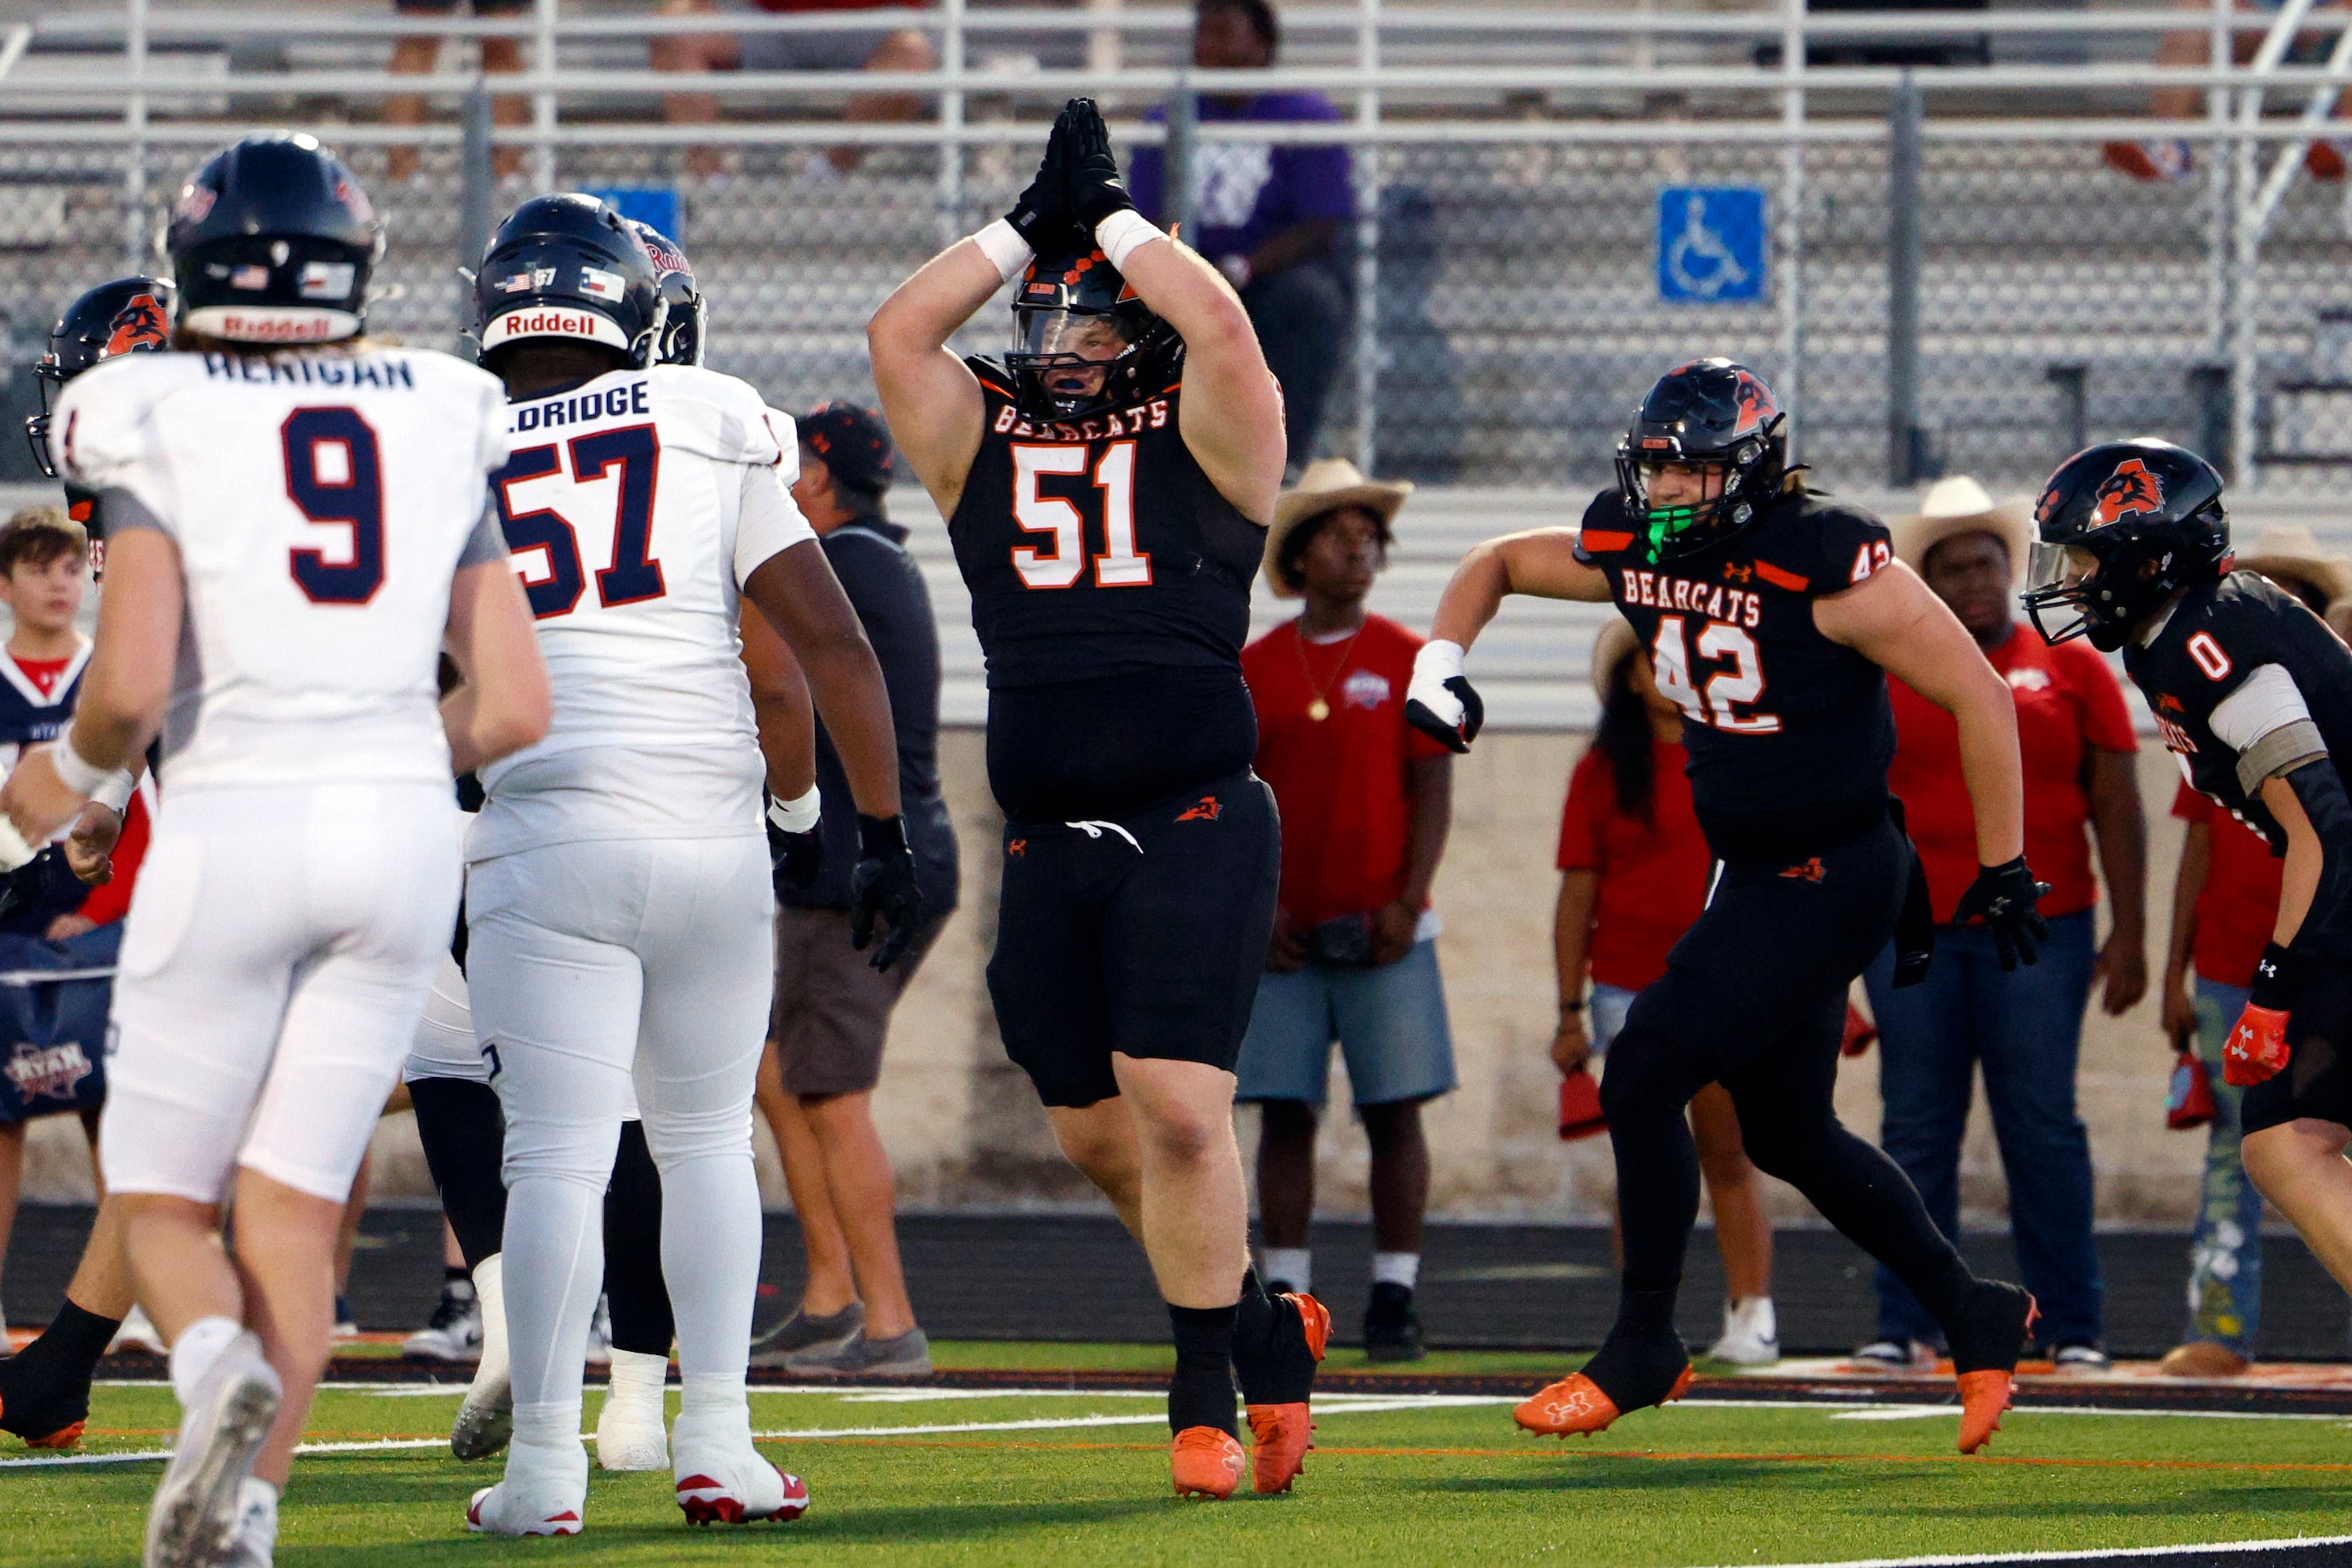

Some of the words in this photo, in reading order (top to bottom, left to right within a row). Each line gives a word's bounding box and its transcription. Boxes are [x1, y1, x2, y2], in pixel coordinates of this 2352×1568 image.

[507, 314, 594, 335] Riddell
[508, 381, 650, 433] DRIDGE
[281, 406, 384, 605] 9
[488, 422, 666, 620] 57
[1009, 439, 1153, 589] 51
[1621, 567, 1761, 628] BEARCATS
[1651, 614, 1784, 736] 42
[2186, 630, 2232, 682] 0
